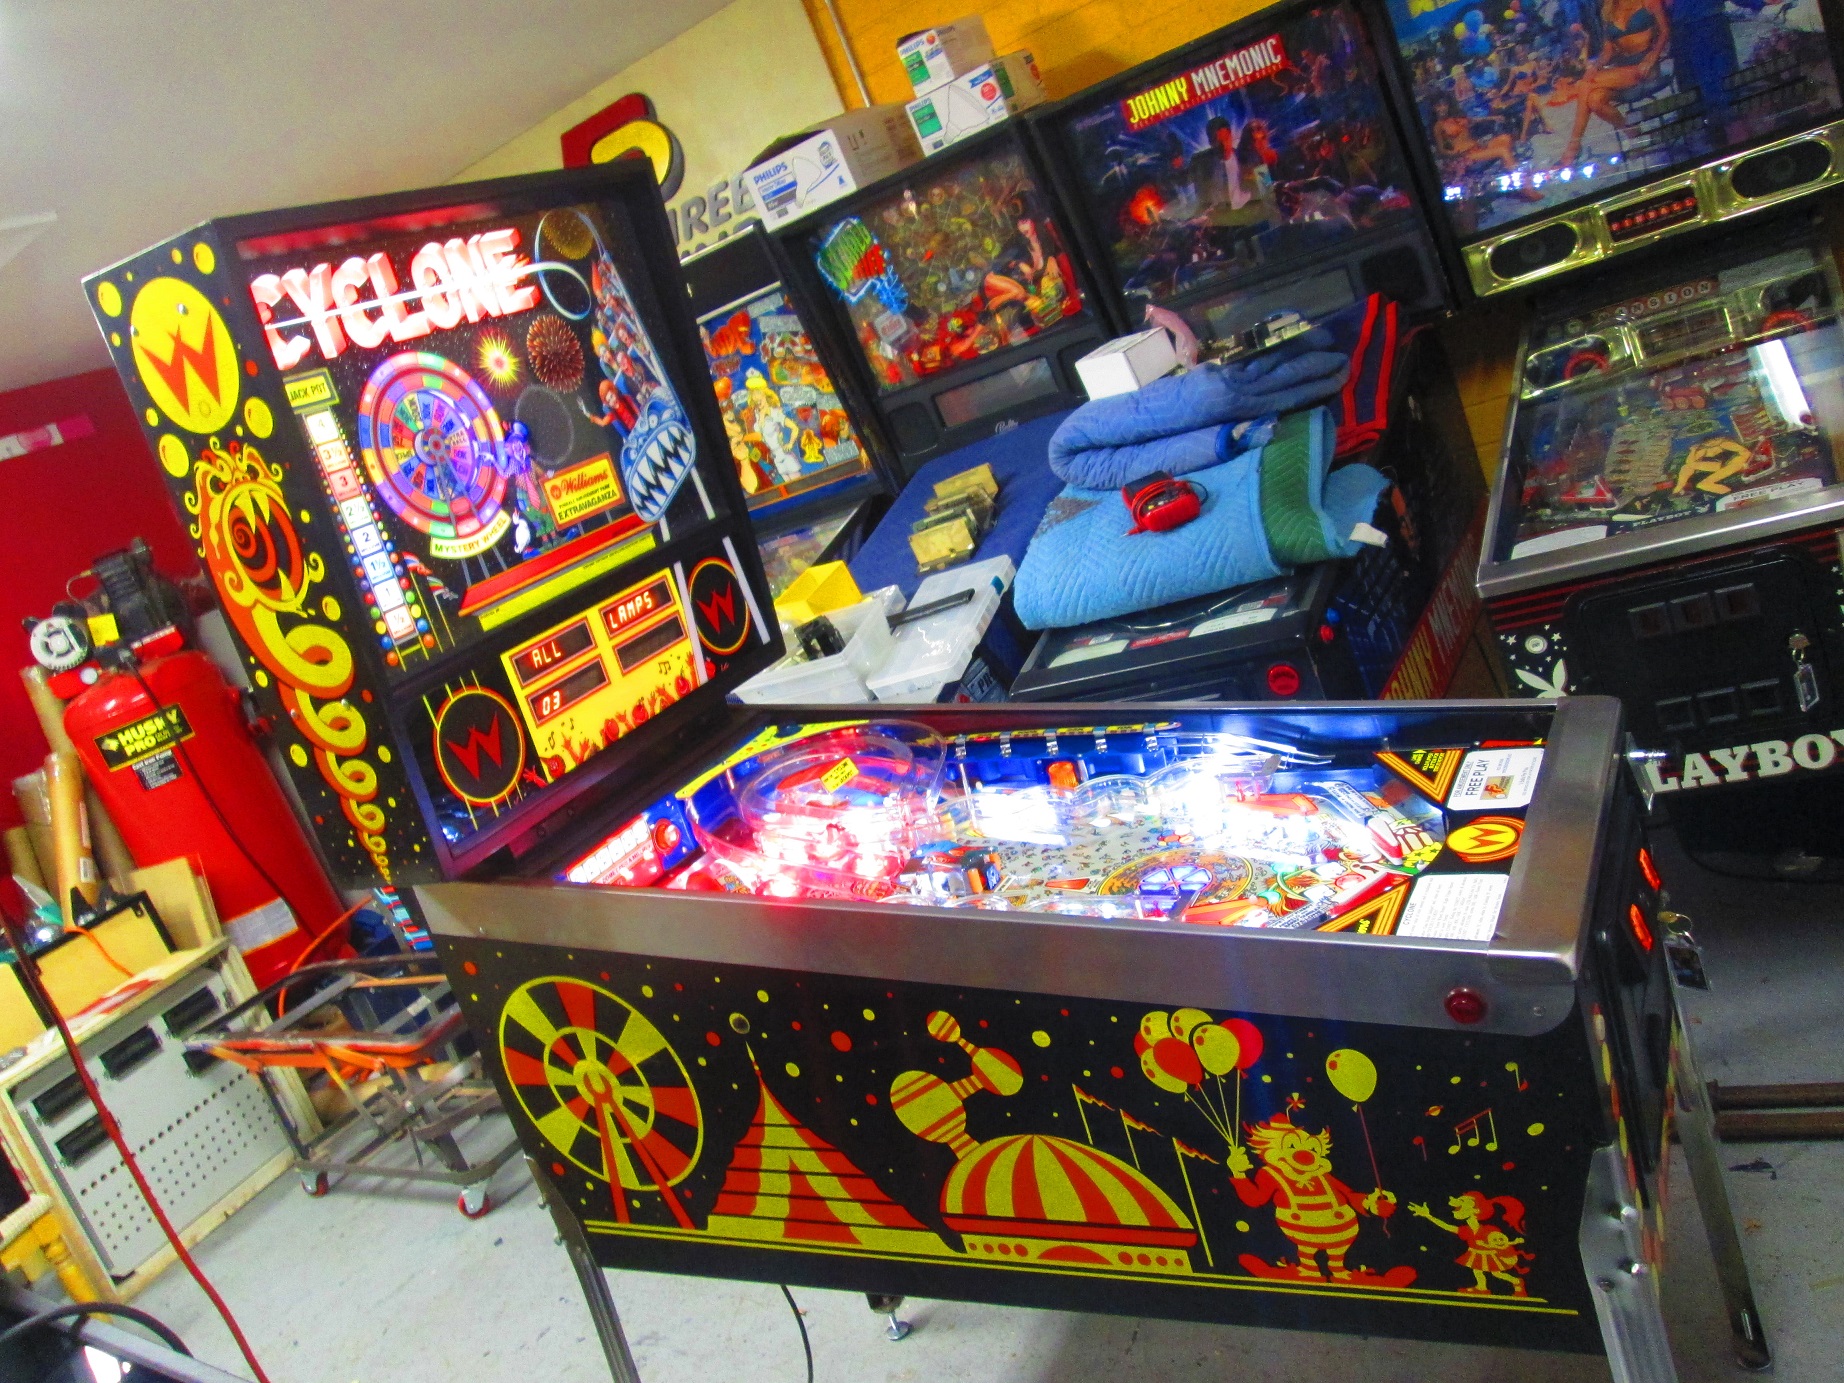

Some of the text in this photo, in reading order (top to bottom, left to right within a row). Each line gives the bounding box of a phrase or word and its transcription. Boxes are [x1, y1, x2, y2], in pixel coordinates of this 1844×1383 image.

[1126, 38, 1282, 124] JOHNNY MNEMONIC
[753, 161, 789, 186] PHILIPS
[250, 227, 540, 371] CYCLONE
[289, 382, 326, 401] JACK POT
[338, 475, 348, 487] 3
[561, 469, 609, 496] Williams
[558, 489, 618, 521] EXTRAVAGANZA
[362, 532, 371, 543] 2
[435, 518, 507, 553] MYSTERY WHEEL
[609, 591, 653, 629] LAMPS
[531, 641, 562, 669] ALL
[542, 690, 561, 716] 03
[124, 735, 157, 757] PRO
[1465, 759, 1490, 796] FREE PLAY
[1403, 902, 1417, 926] CYCLONE
